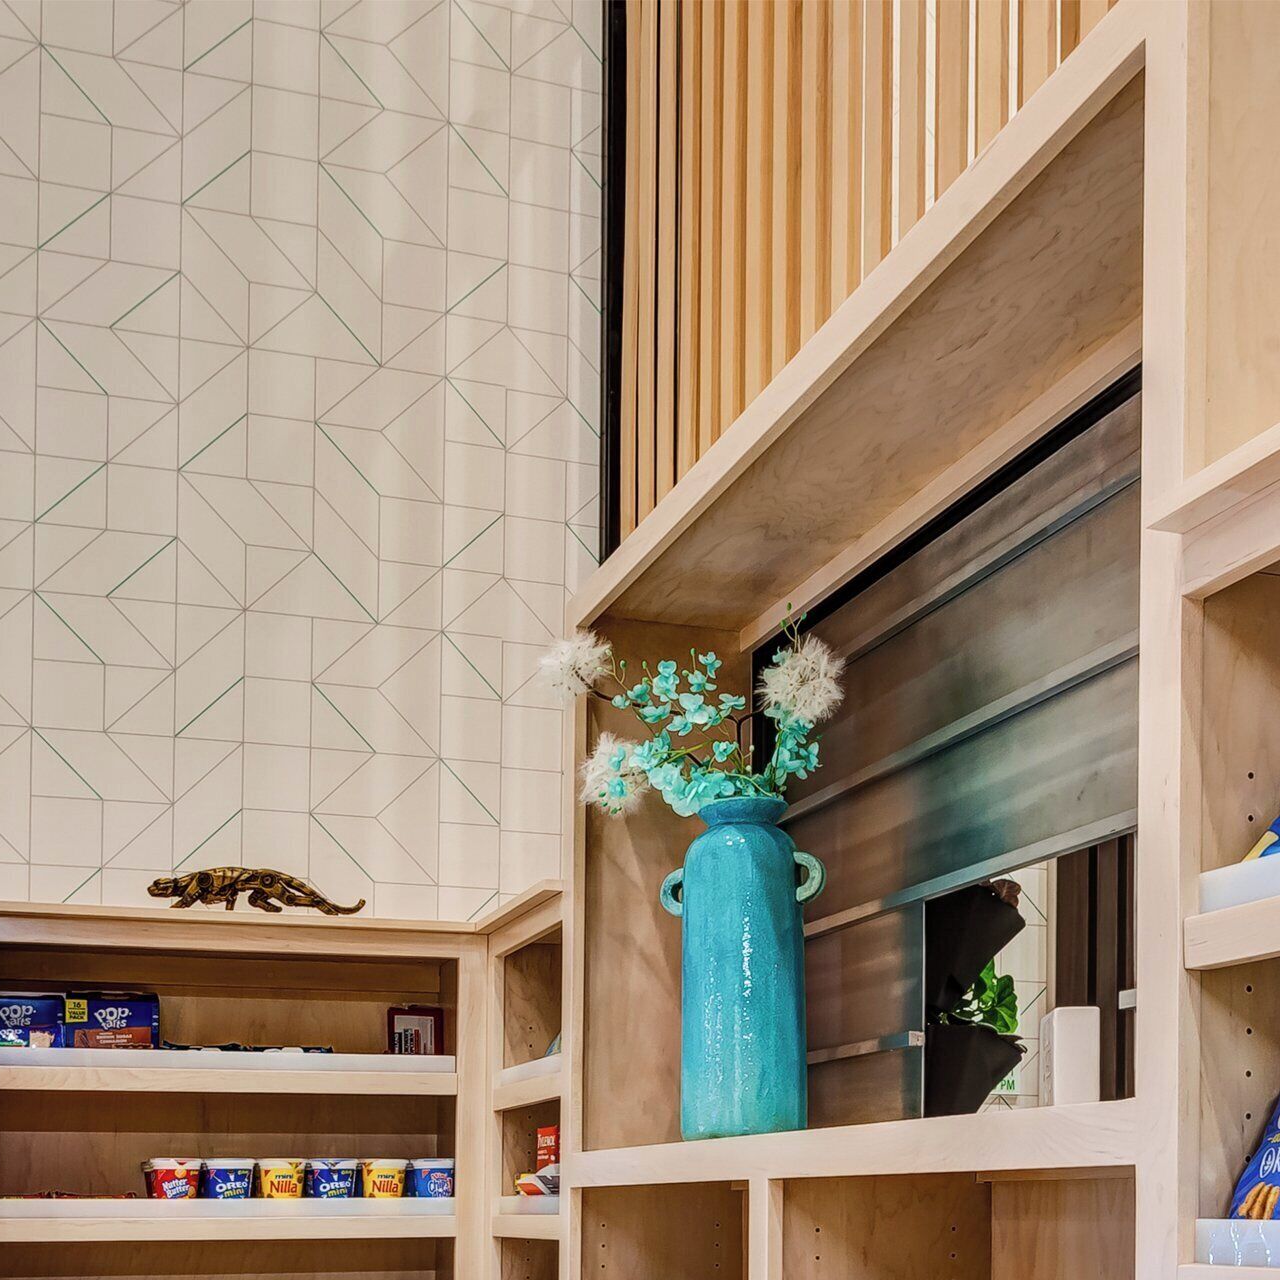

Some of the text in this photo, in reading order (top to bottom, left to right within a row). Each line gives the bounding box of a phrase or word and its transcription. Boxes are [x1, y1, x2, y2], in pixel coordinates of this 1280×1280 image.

[73, 1001, 82, 1009] 16
[162, 1179, 188, 1191] Nutter
[216, 1182, 248, 1193] OREO
[269, 1180, 298, 1194] Nilla
[320, 1182, 351, 1192] OREO
[371, 1180, 399, 1193] Nilla
[166, 1185, 190, 1199] Butter
[224, 1189, 245, 1198] mini
[327, 1188, 348, 1198] mini
